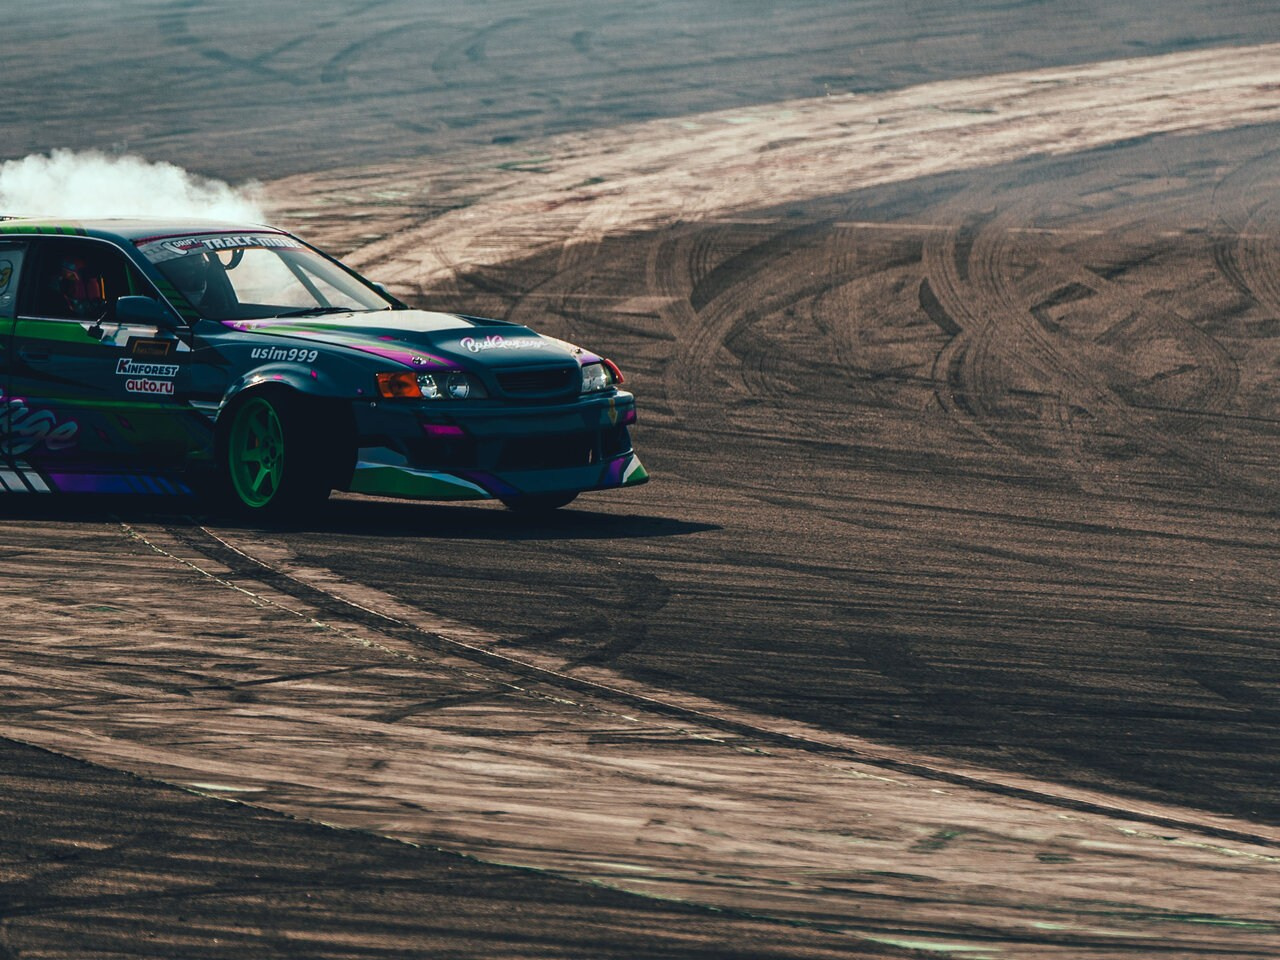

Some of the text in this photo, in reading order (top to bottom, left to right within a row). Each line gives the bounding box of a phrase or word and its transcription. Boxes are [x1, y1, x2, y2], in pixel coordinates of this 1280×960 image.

[460, 335, 549, 353] BadGar
[251, 346, 318, 362] usim999
[118, 359, 178, 376] KINFOREST
[126, 379, 174, 393] auto.ru
